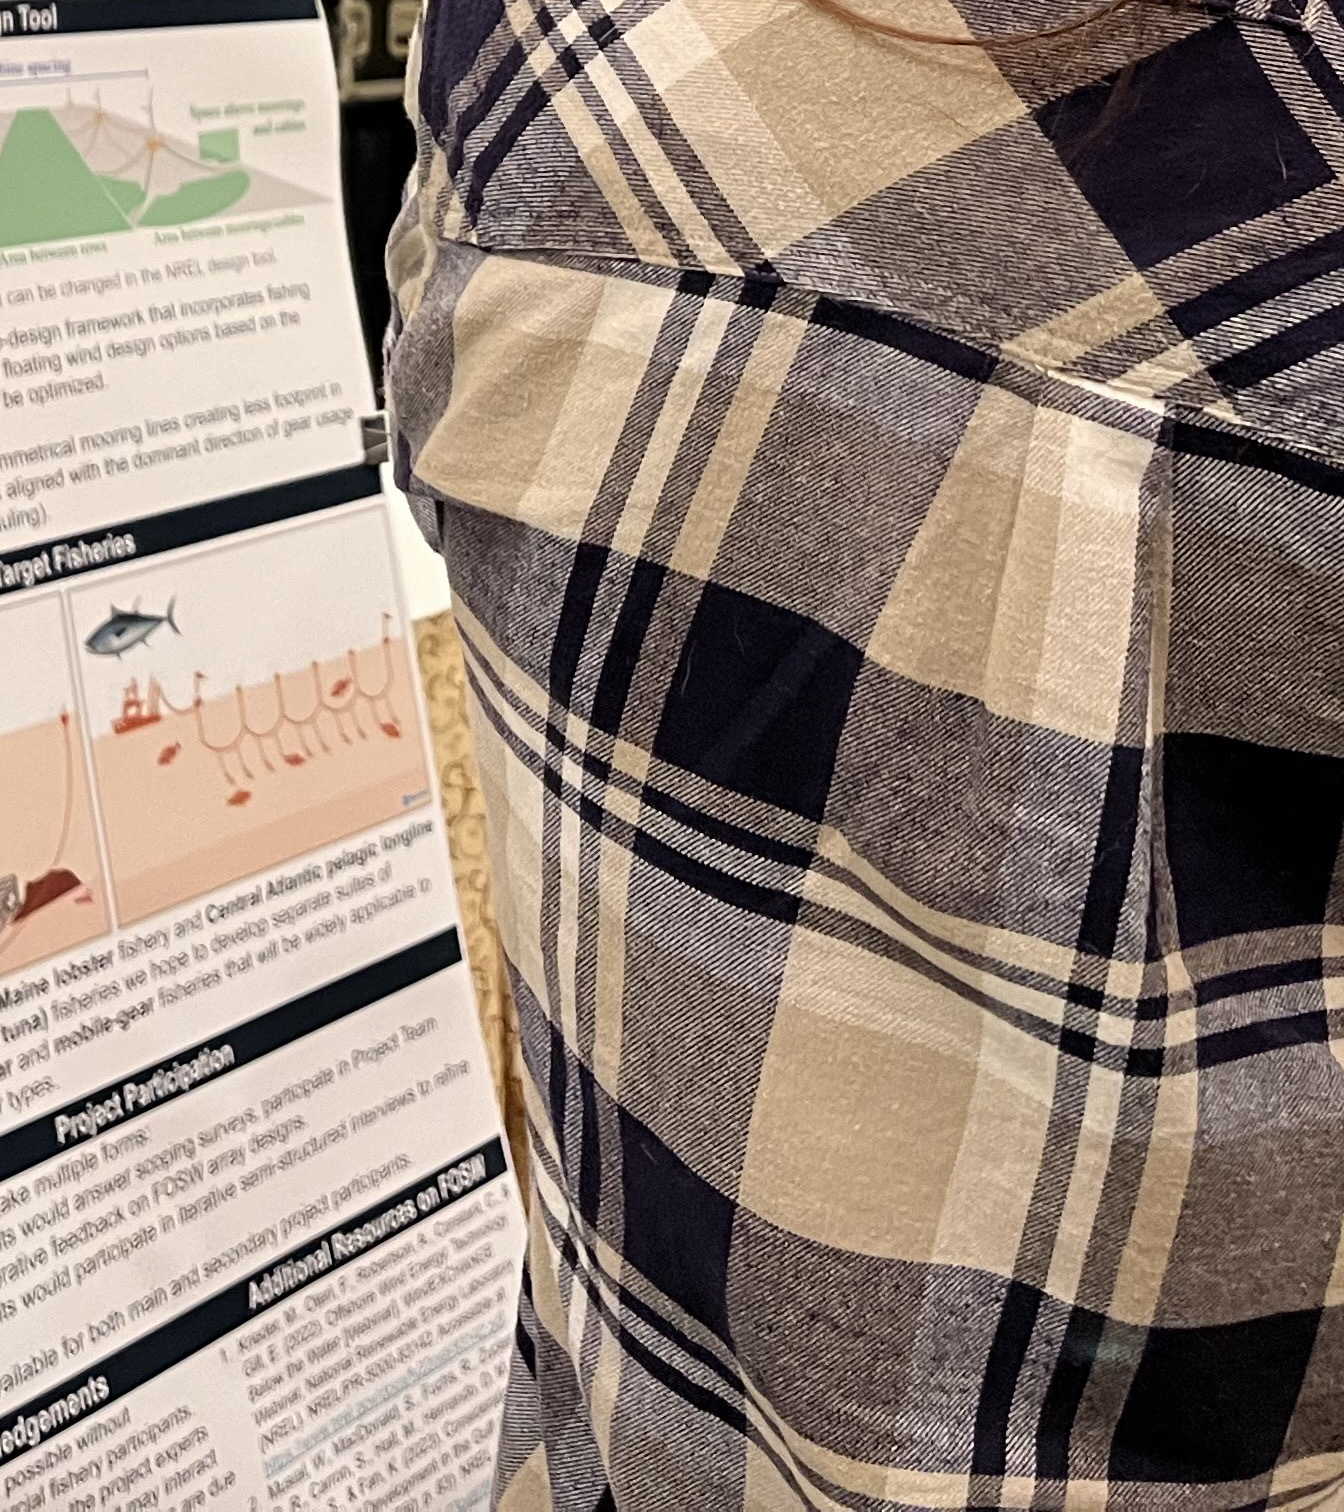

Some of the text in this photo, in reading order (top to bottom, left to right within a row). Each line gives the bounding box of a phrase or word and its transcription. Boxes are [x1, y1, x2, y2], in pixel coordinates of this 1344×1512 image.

[17, 5, 58, 32] Tool
[64, 307, 146, 338] framework
[52, 534, 137, 573] Fisheries
[55, 1045, 234, 1144] Project Participation
[33, 1152, 99, 1197] multiple
[100, 1125, 153, 1164] forms:
[249, 1155, 486, 1309] Additional Resources on FOSW
